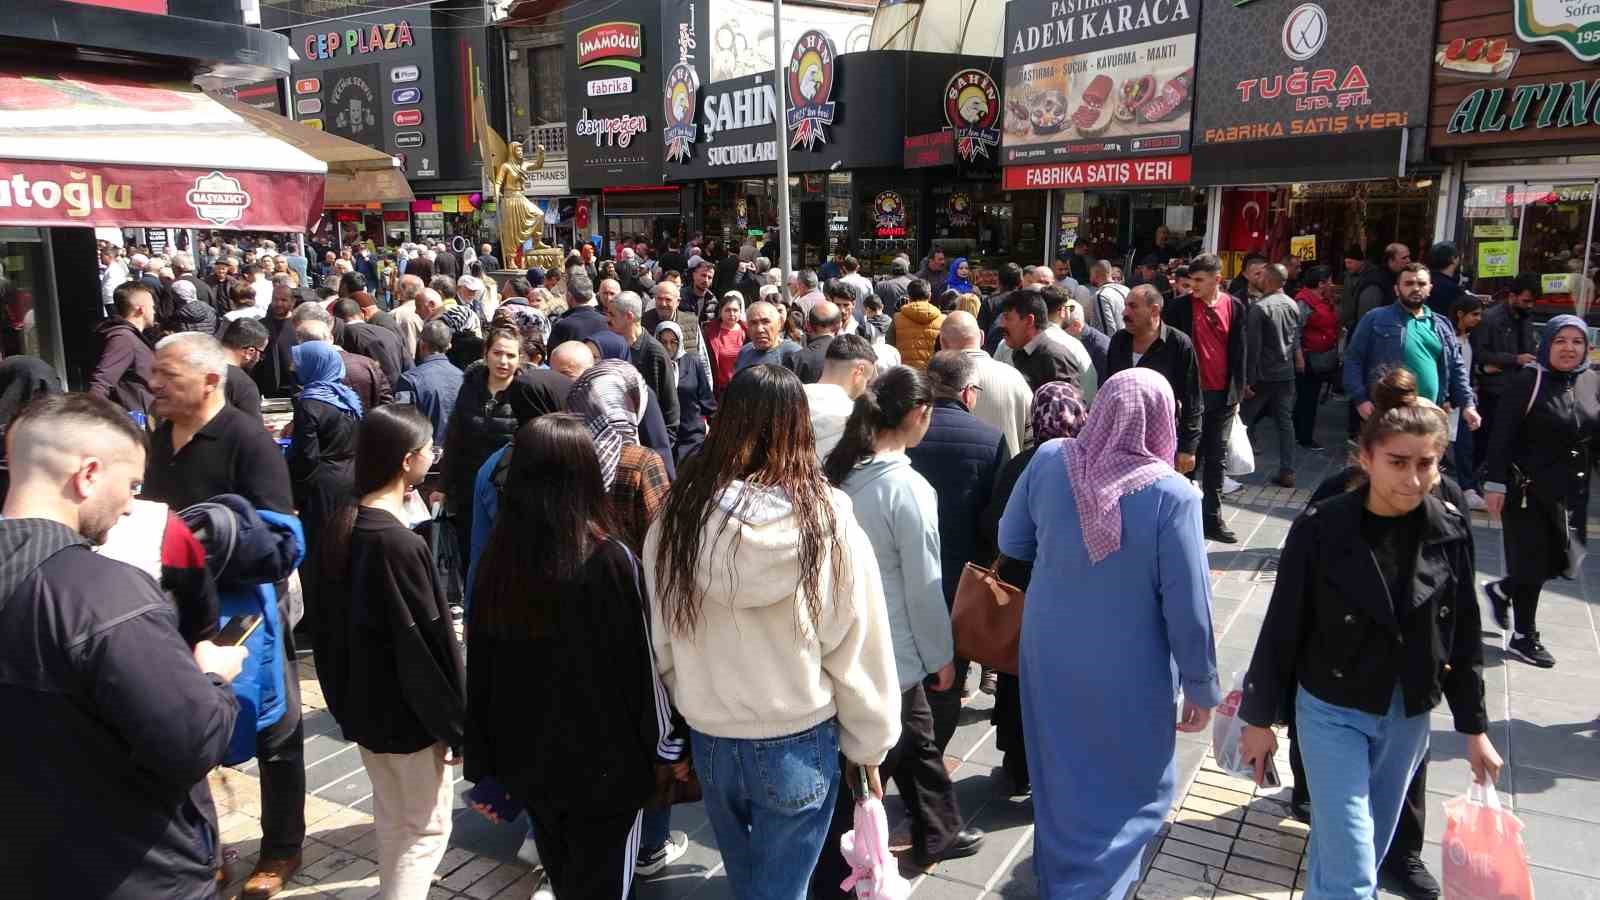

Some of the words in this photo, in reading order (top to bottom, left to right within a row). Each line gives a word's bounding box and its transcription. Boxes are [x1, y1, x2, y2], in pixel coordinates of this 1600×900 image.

[305, 32, 340, 60] CEP
[346, 20, 413, 56] PLAZA
[1012, 17, 1074, 54] ADEM
[1080, 0, 1190, 41] KARACA
[1062, 60, 1088, 74] SUCUK
[1096, 51, 1137, 70] KAVURMA
[1146, 44, 1177, 63] MANTI
[592, 82, 629, 95] fabrika
[1237, 64, 1370, 102] TUĞRA
[704, 75, 777, 142] ŞAHİN
[1296, 96, 1333, 111] LTD.
[1290, 115, 1349, 135] SATIŞ
[1087, 163, 1130, 184] SATIŞ
[1134, 160, 1173, 181] YERİ
